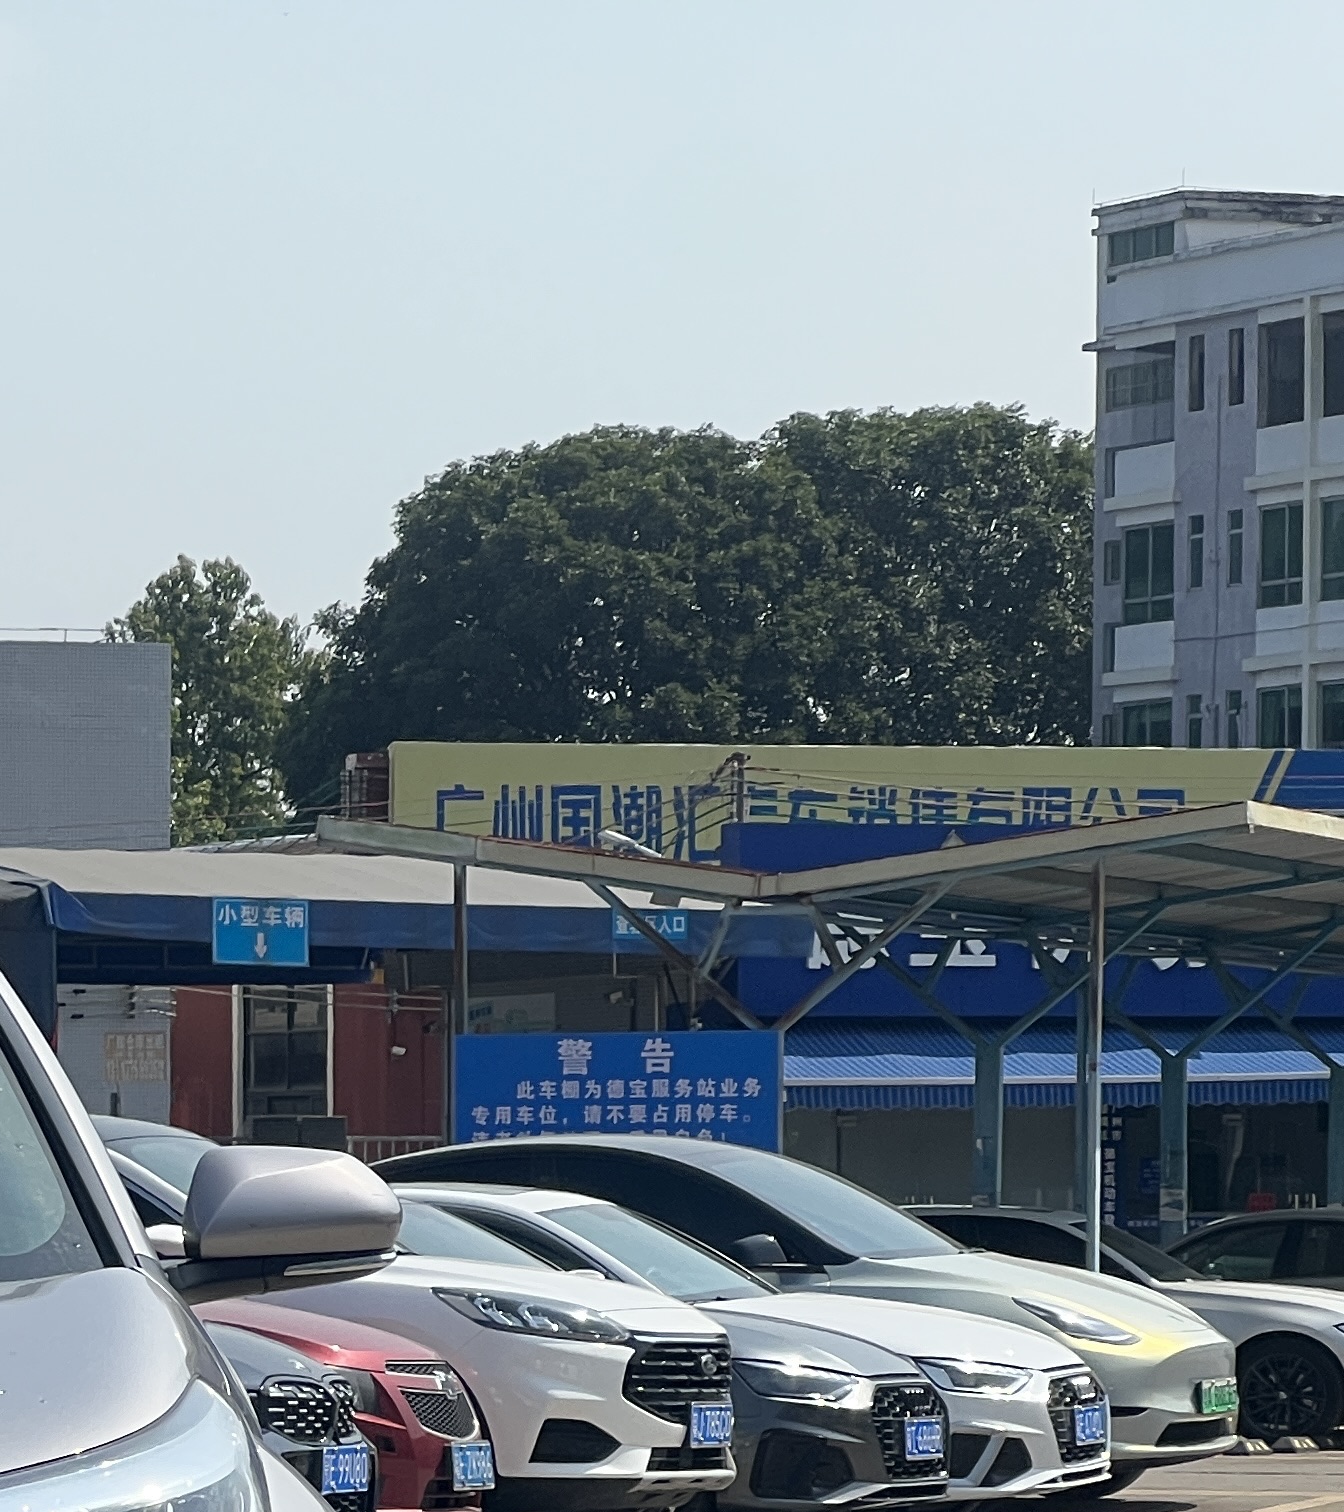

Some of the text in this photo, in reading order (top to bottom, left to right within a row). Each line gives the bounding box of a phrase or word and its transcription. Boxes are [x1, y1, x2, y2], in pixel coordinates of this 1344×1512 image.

[218, 904, 304, 928] 小型车辆
[557, 1037, 675, 1076] 警告
